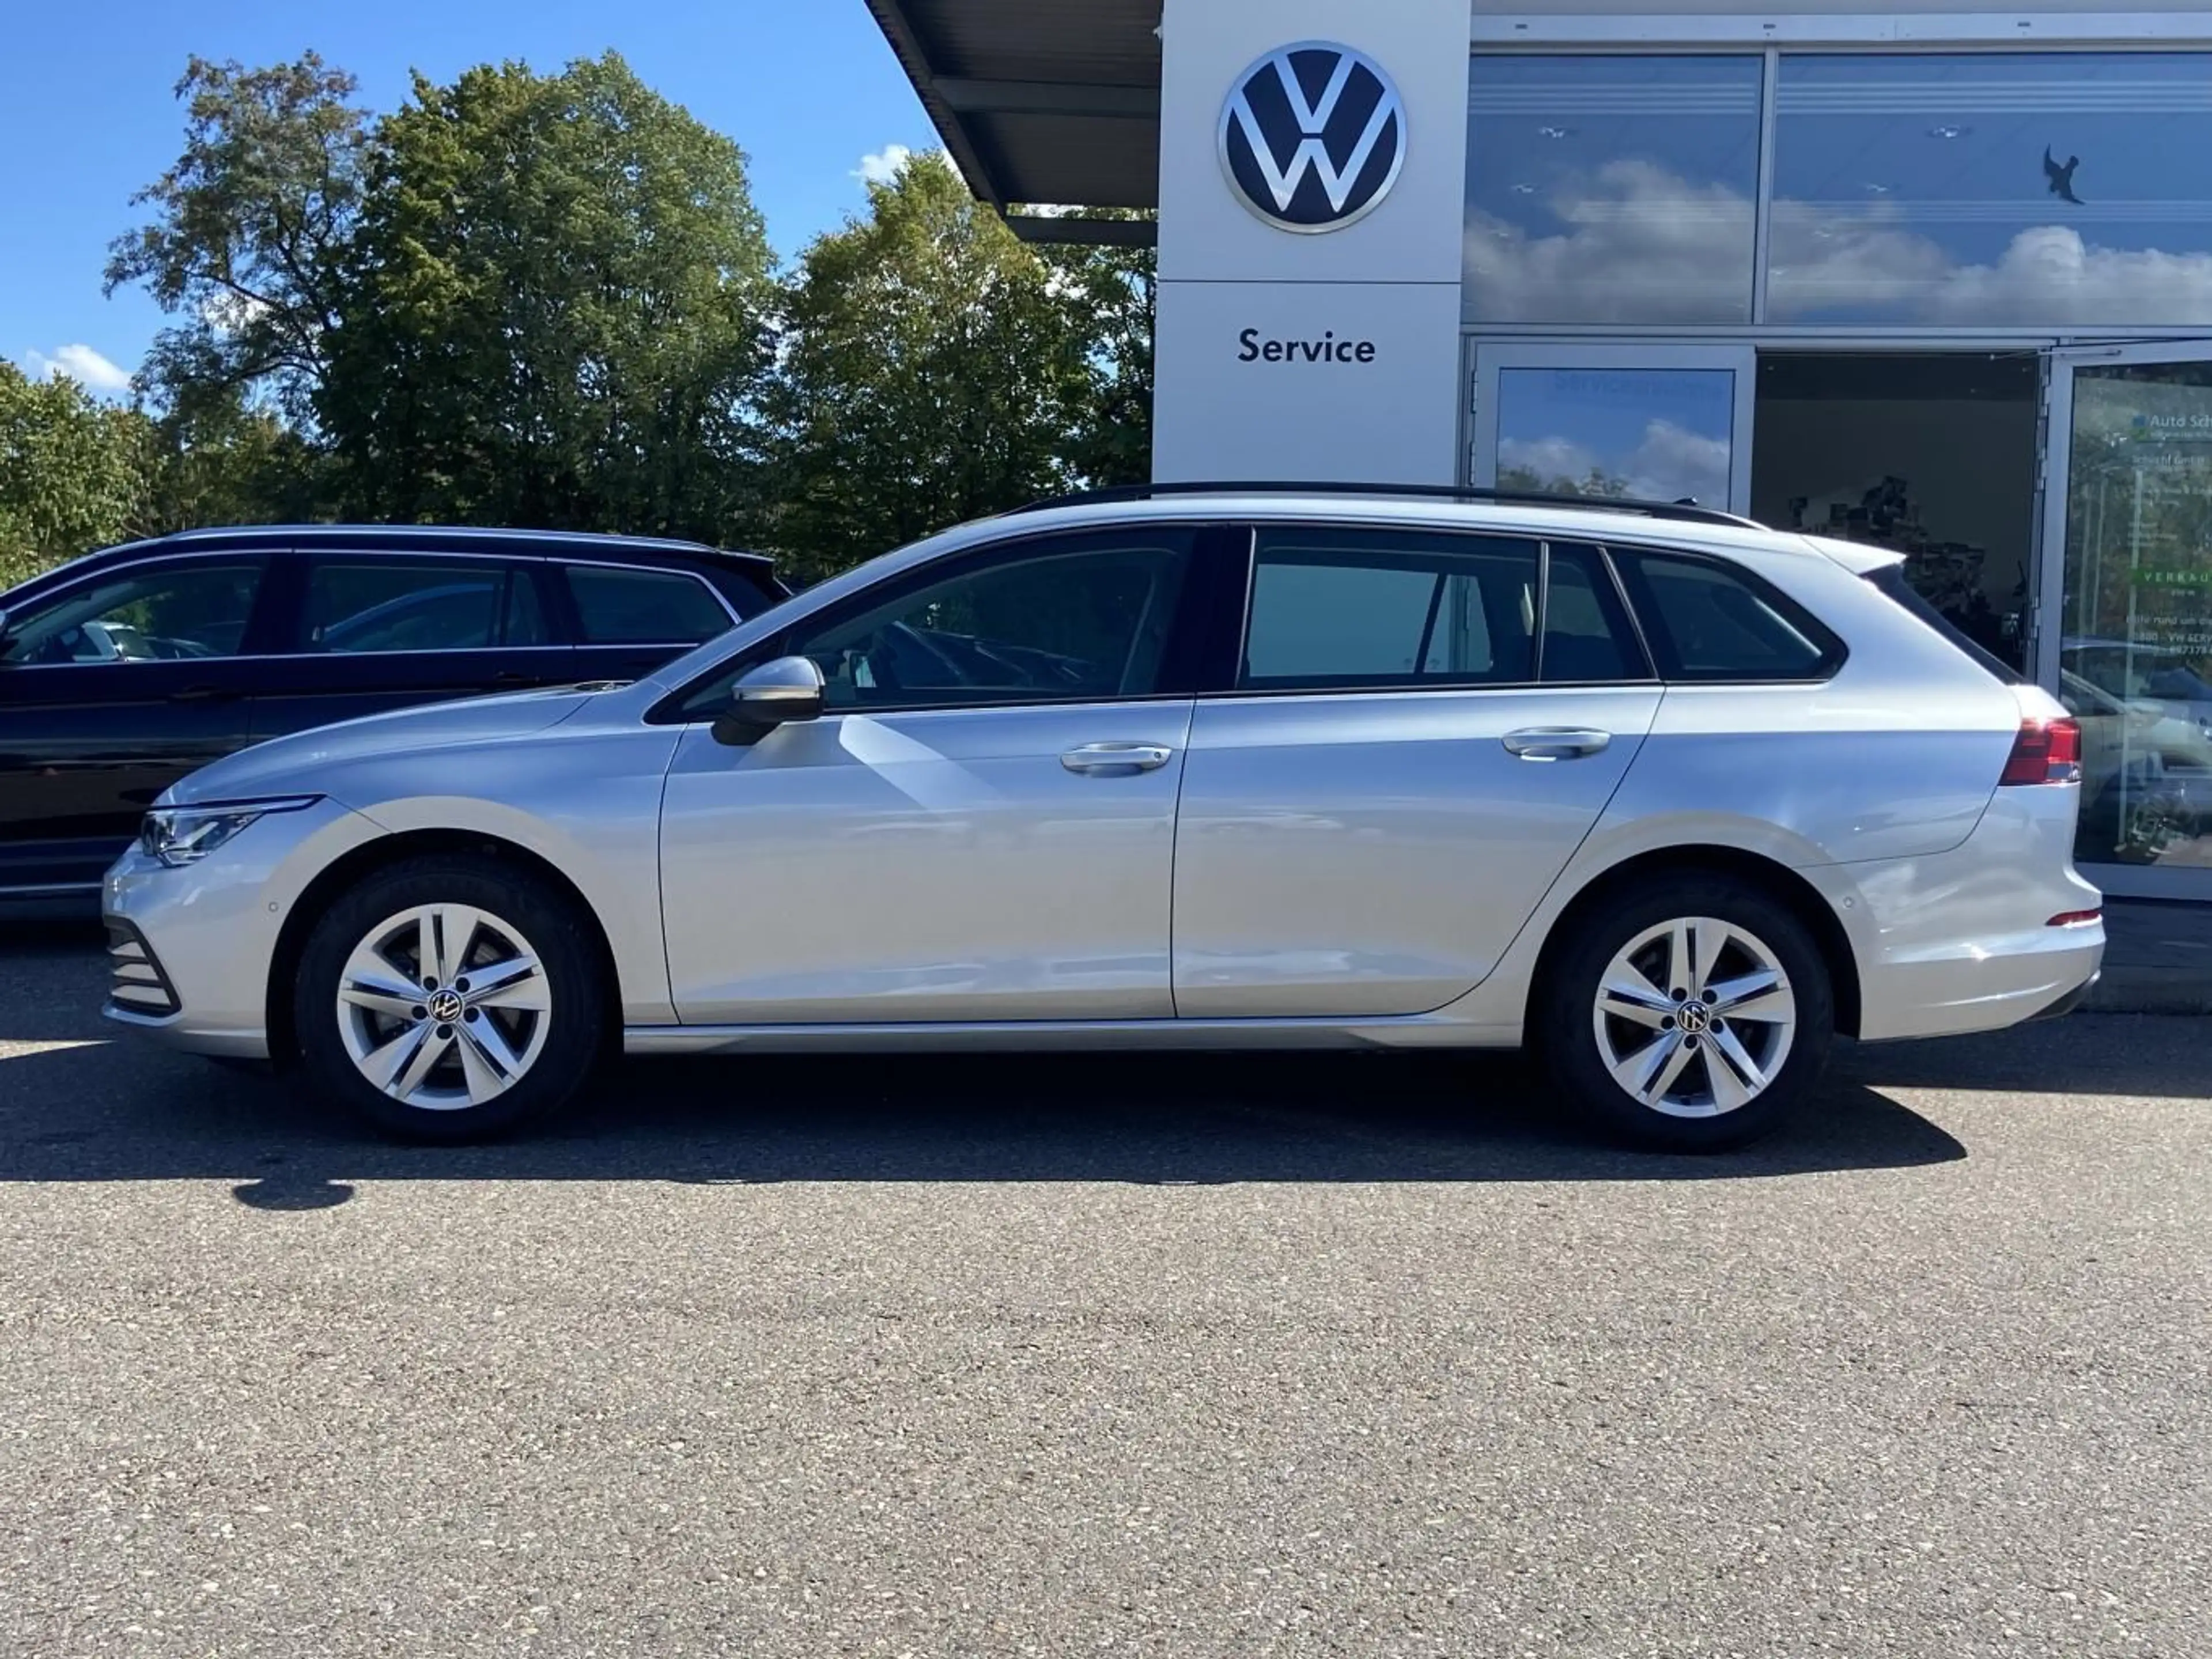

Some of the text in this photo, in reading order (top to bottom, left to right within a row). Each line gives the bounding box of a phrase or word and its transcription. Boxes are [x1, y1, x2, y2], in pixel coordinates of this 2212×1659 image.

[1223, 45, 1403, 227] VW
[1238, 328, 1375, 362] Service
[2150, 414, 2185, 427] Auto
